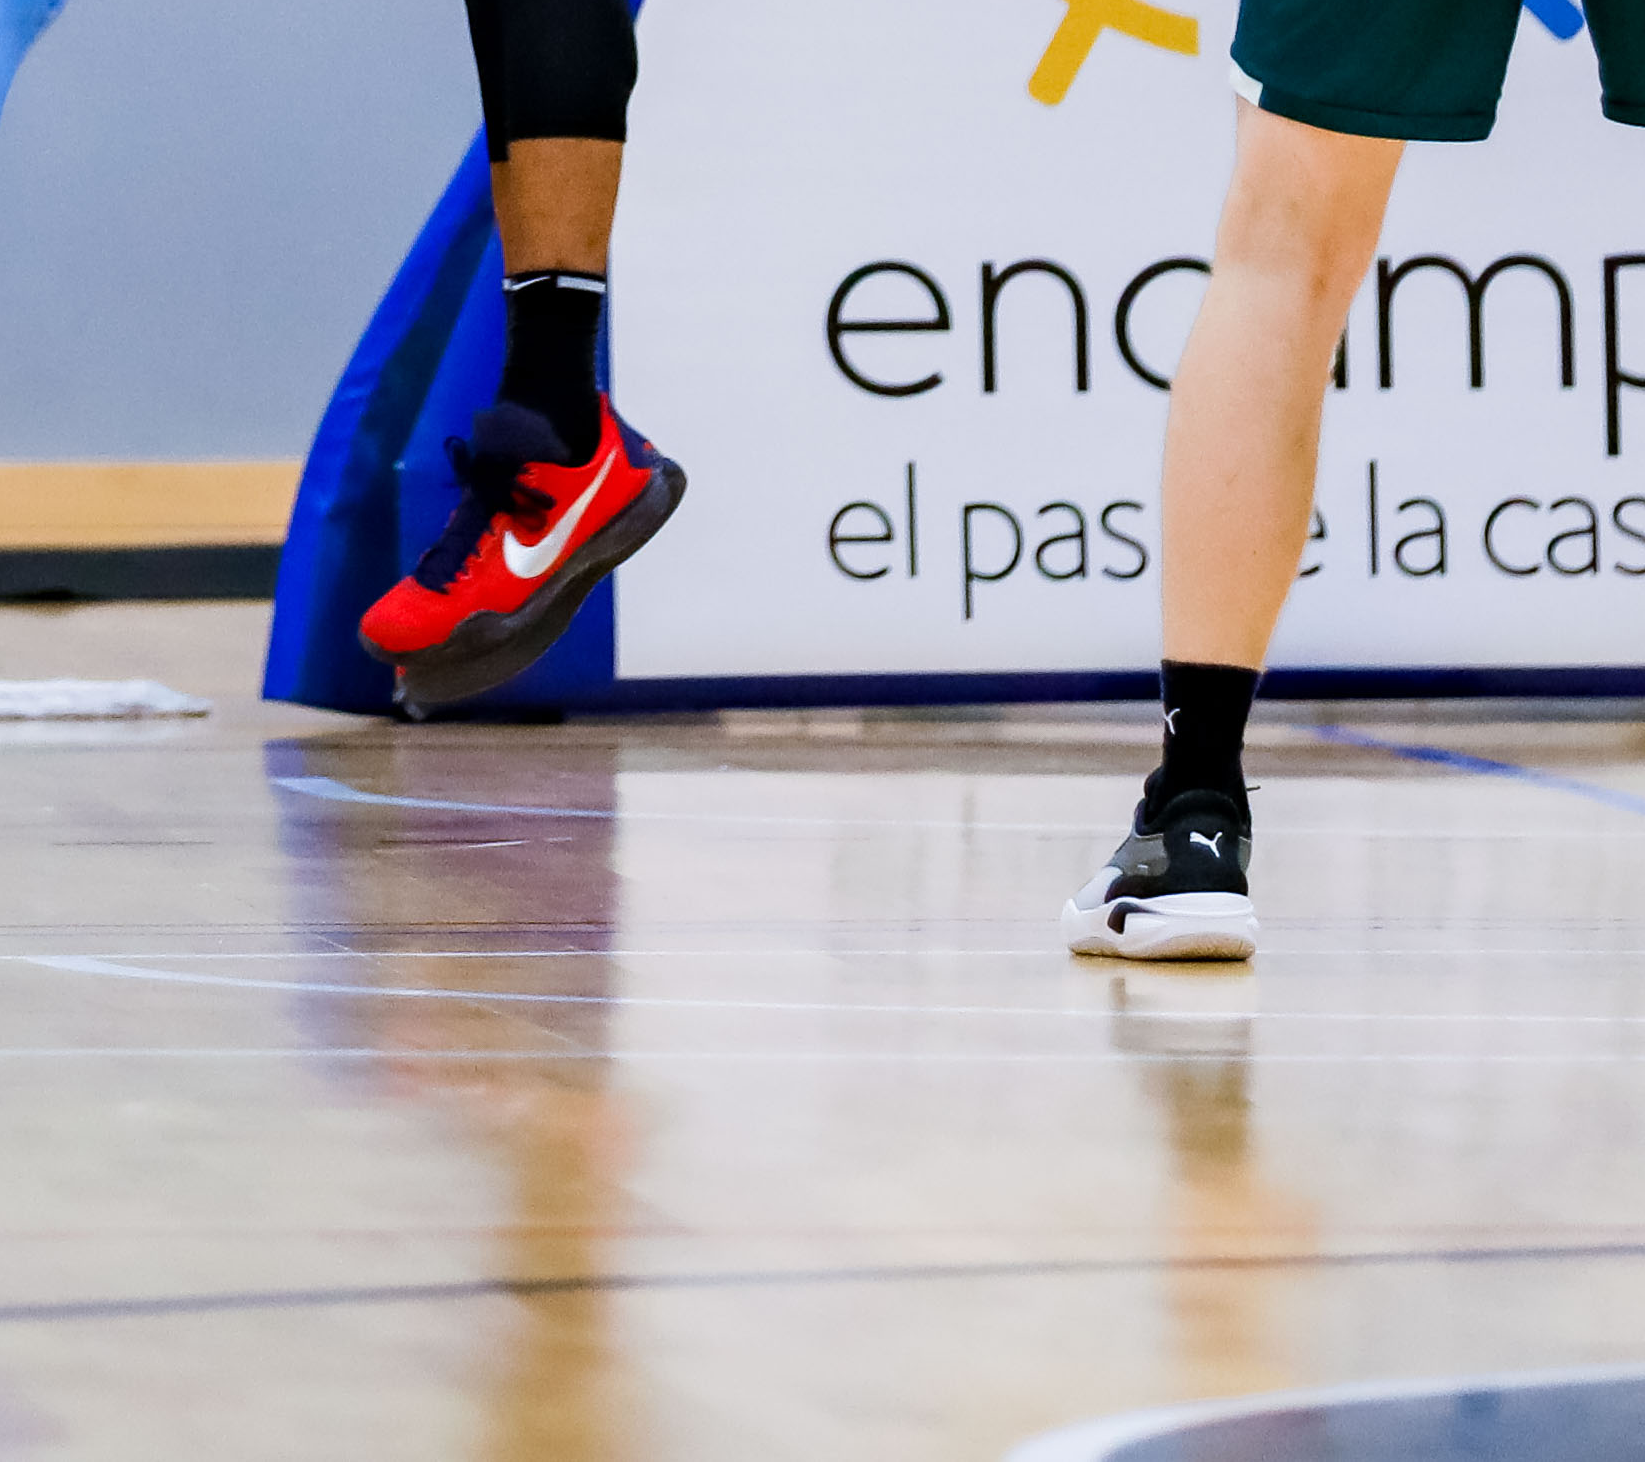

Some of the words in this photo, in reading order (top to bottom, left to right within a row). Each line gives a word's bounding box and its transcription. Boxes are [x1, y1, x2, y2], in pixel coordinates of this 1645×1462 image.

[827, 461, 917, 580] el
[962, 501, 1150, 622] pas
[1365, 459, 1449, 578] la
